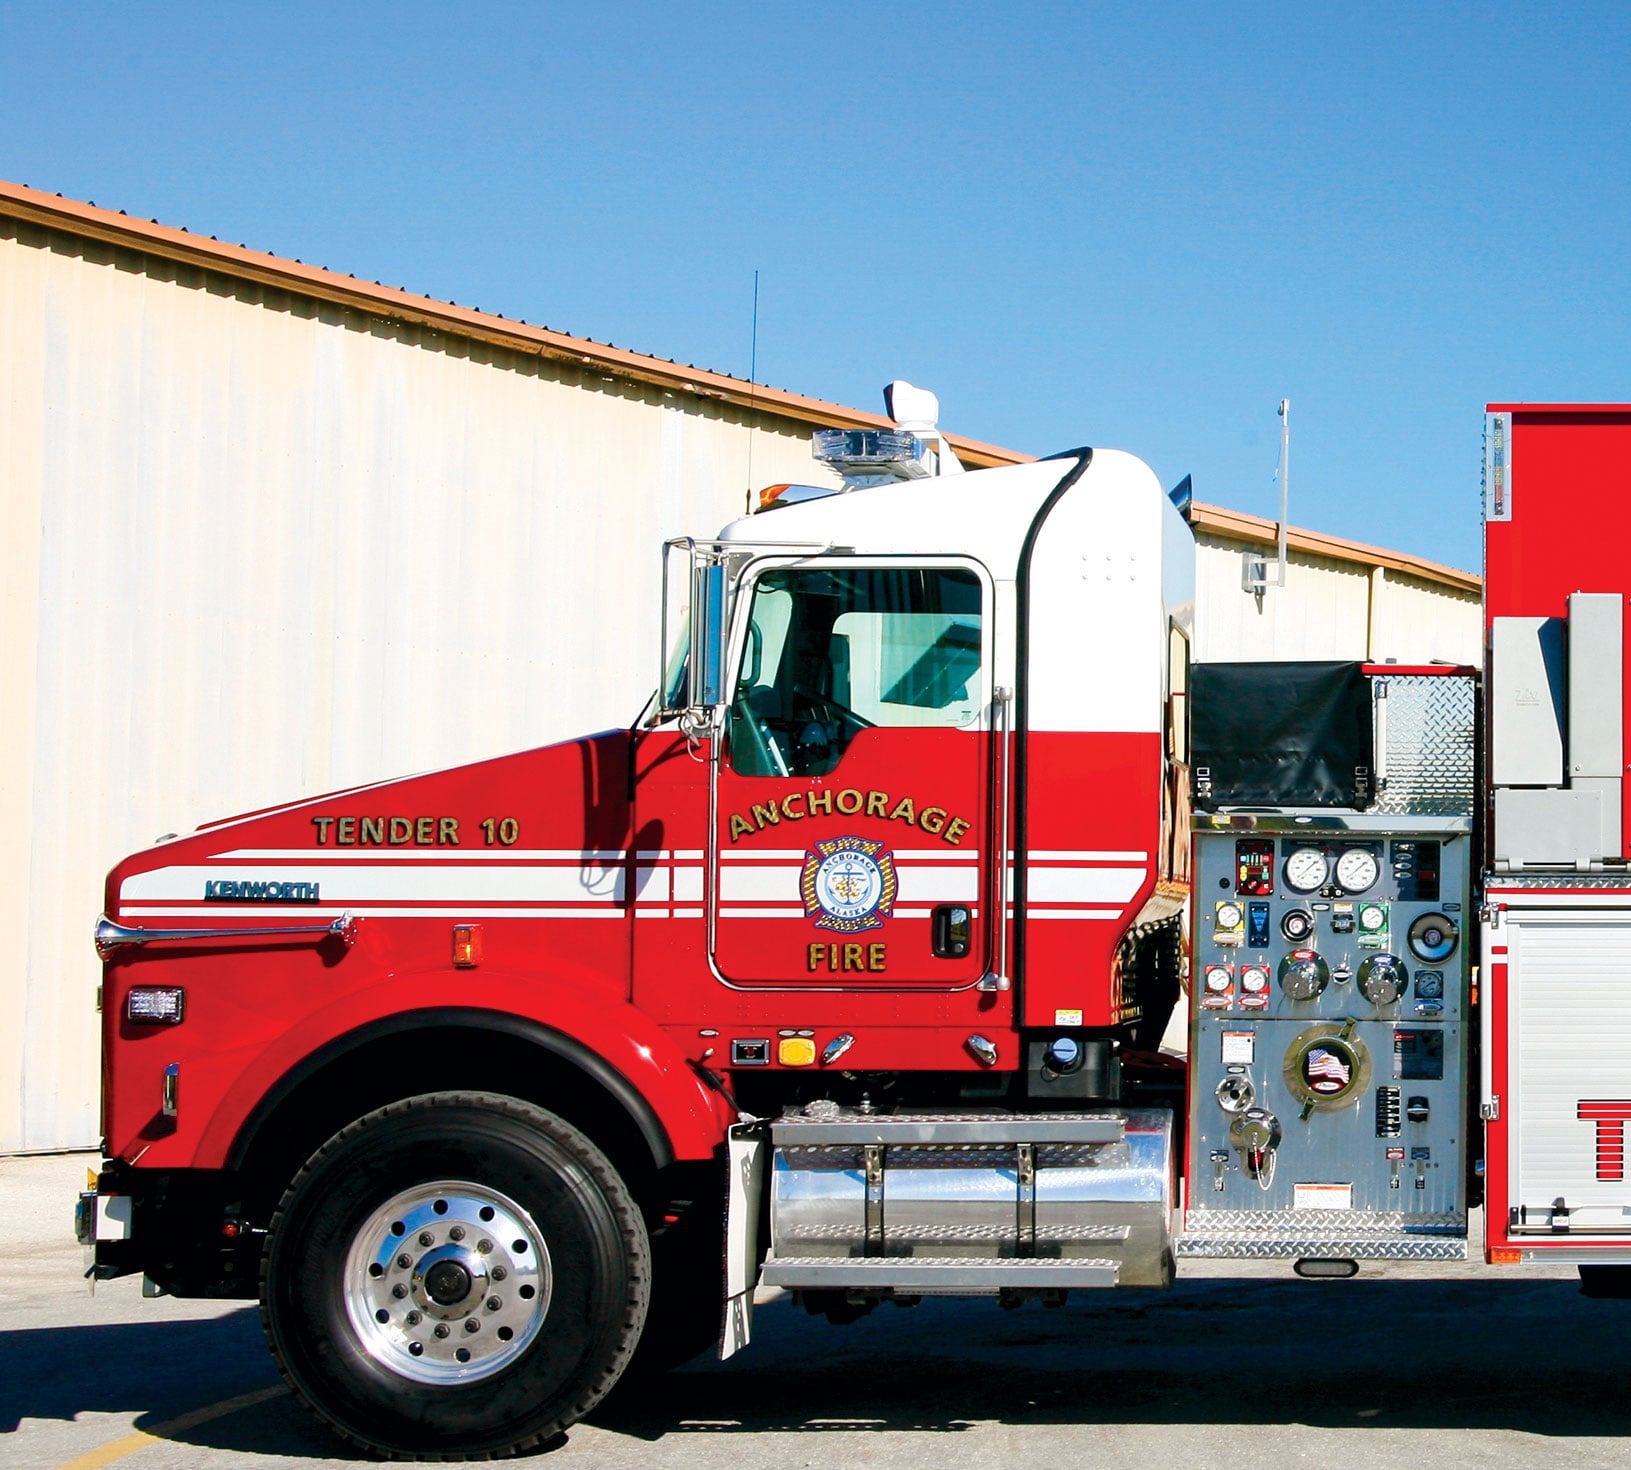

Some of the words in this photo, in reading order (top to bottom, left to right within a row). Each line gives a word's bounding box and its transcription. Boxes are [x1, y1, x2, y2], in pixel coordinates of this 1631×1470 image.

[730, 788, 971, 845] ANCHORAGE
[313, 816, 460, 846] TENDER
[481, 817, 520, 845] 10
[823, 853, 876, 874] ANCHORAGE
[205, 880, 320, 899] KENWORTH
[830, 906, 867, 917] ALASKA
[808, 942, 887, 972] FIRE
